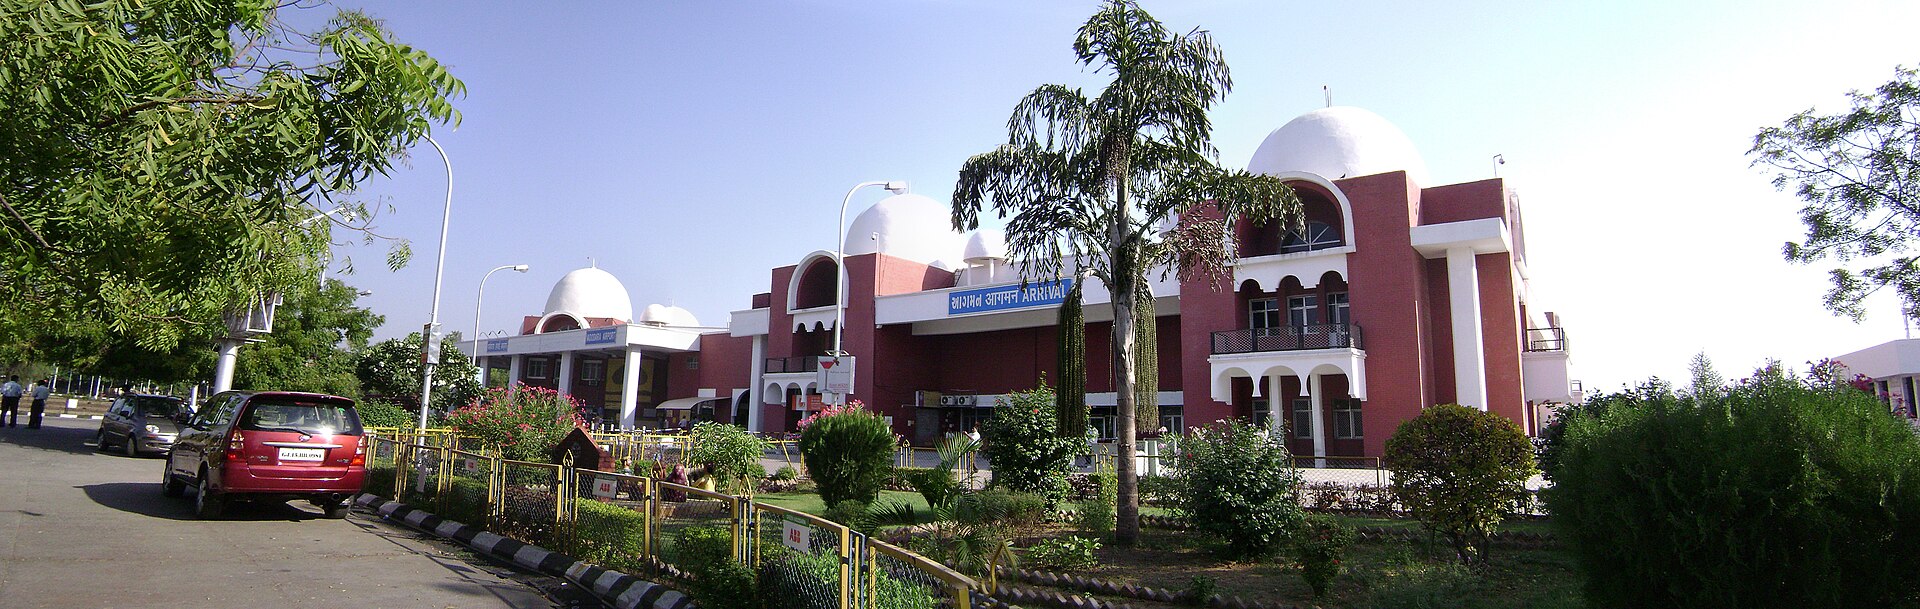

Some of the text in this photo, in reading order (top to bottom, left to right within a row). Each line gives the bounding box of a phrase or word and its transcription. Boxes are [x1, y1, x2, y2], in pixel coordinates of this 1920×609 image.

[985, 288, 1018, 306] आगमन
[1021, 284, 1066, 303] ARRIVAL
[789, 528, 801, 543] ABB
